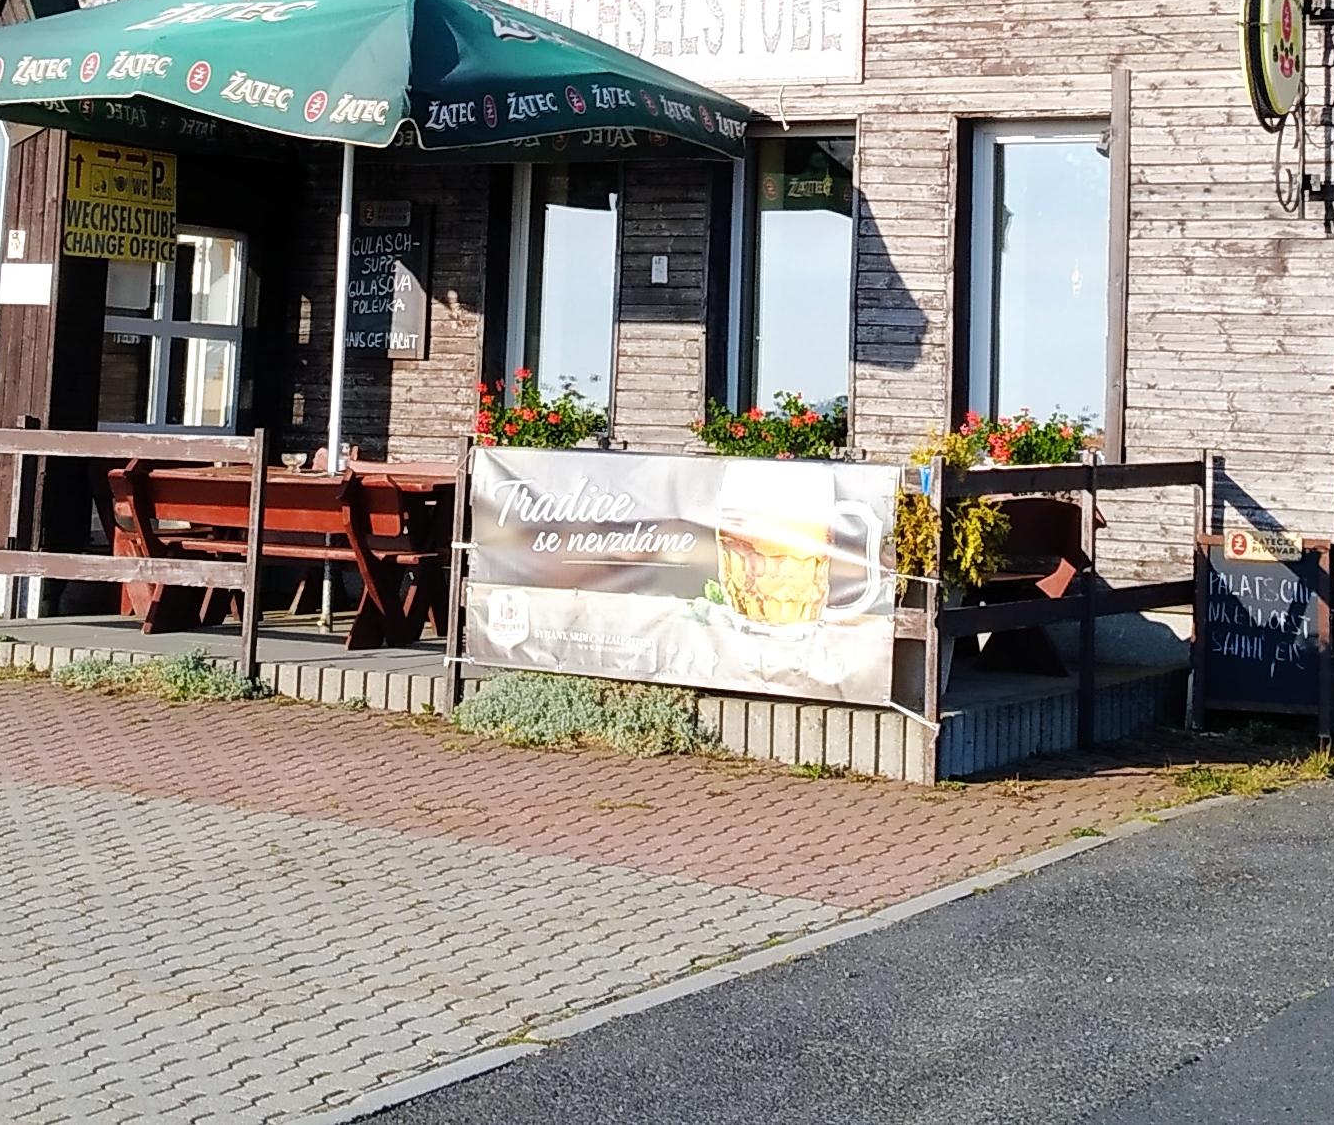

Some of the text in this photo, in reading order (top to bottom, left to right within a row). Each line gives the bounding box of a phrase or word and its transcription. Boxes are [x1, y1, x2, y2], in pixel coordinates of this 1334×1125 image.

[12, 56, 72, 86] ŽATEC
[107, 50, 172, 81] ŽATEC
[220, 70, 294, 112] ŽATEC
[329, 93, 390, 125] ŽATEC
[425, 100, 477, 133] ŽATEC
[506, 92, 560, 123] ŽATEC
[591, 84, 636, 110] ŽATEC
[660, 95, 696, 122] ŽATEC
[132, 178, 148, 196] WC
[152, 160, 166, 200] P
[156, 185, 172, 201] BUS
[67, 200, 176, 238] WECHSELSTUBE
[64, 231, 176, 261] CHANGE OFFICE
[492, 477, 636, 528] Tradice
[531, 521, 697, 554] se nevzdáme
[1252, 546, 1296, 554] PIVOVAR
